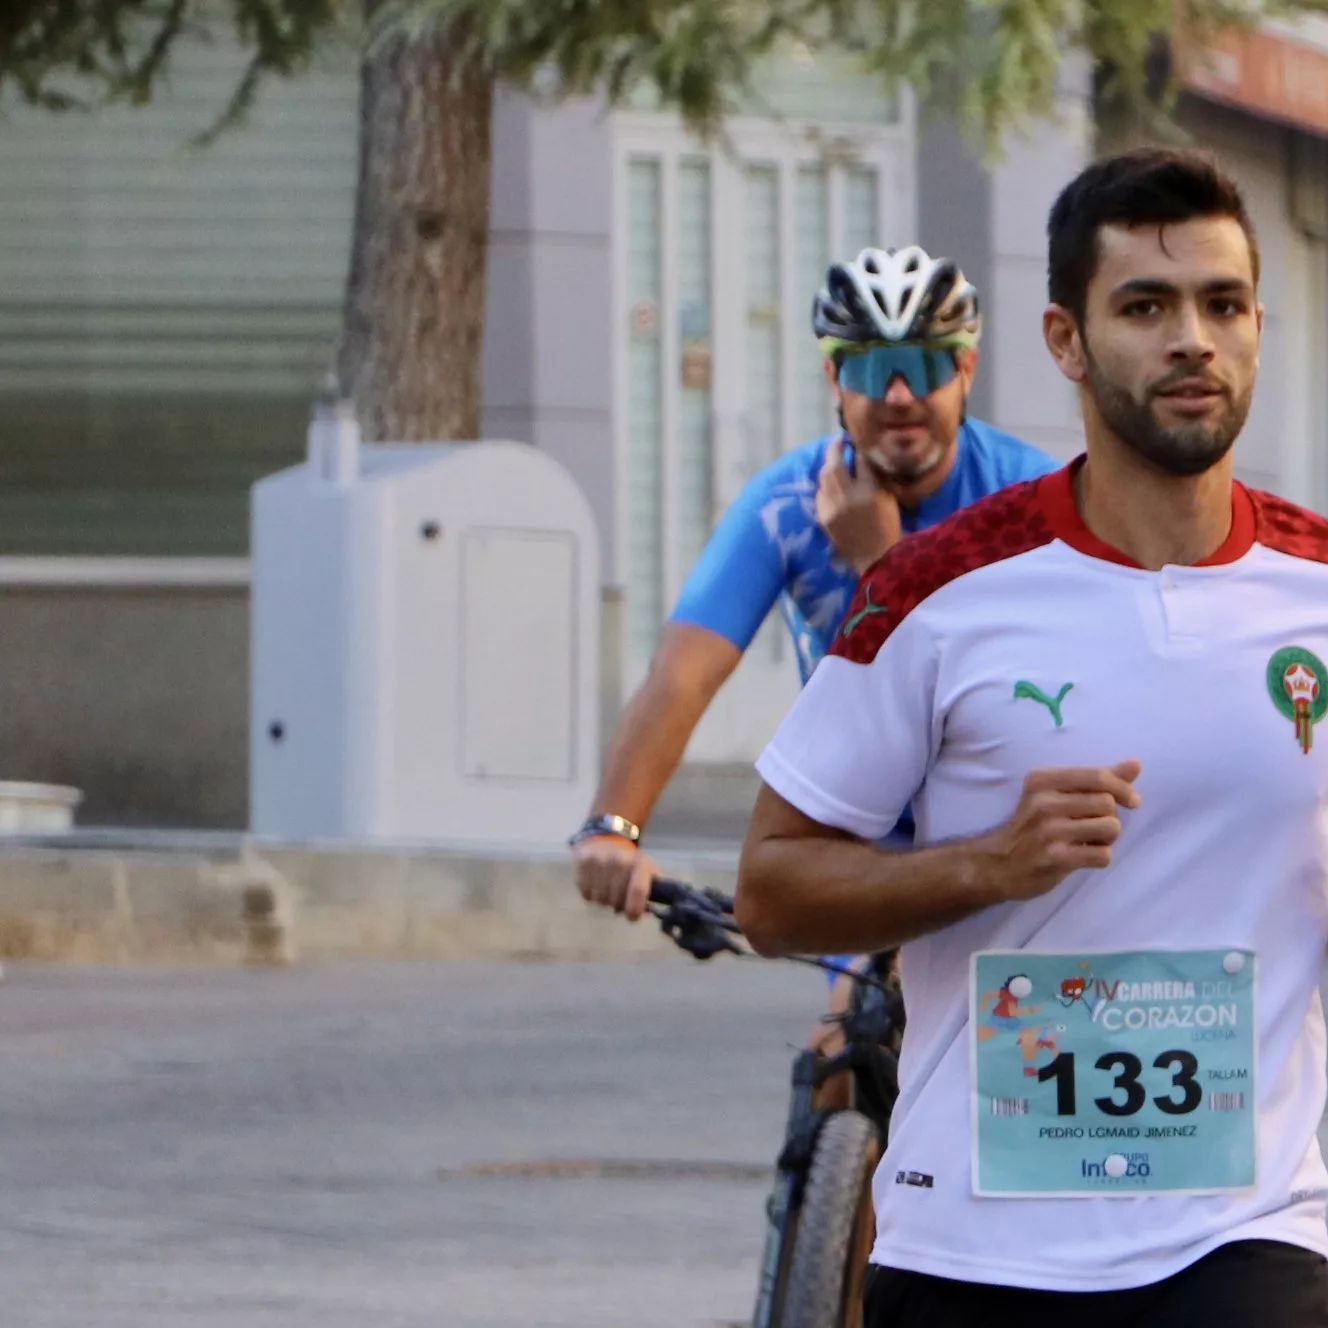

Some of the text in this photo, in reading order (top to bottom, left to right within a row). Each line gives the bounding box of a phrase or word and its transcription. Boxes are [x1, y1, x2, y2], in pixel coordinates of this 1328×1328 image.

[1095, 979, 1120, 1001] IV
[1118, 981, 1195, 1001] CARRERA
[1038, 1050, 1202, 1116] 133
[1039, 1127, 1084, 1139] PEDRO
[1144, 1125, 1198, 1138] JIMENEZ
